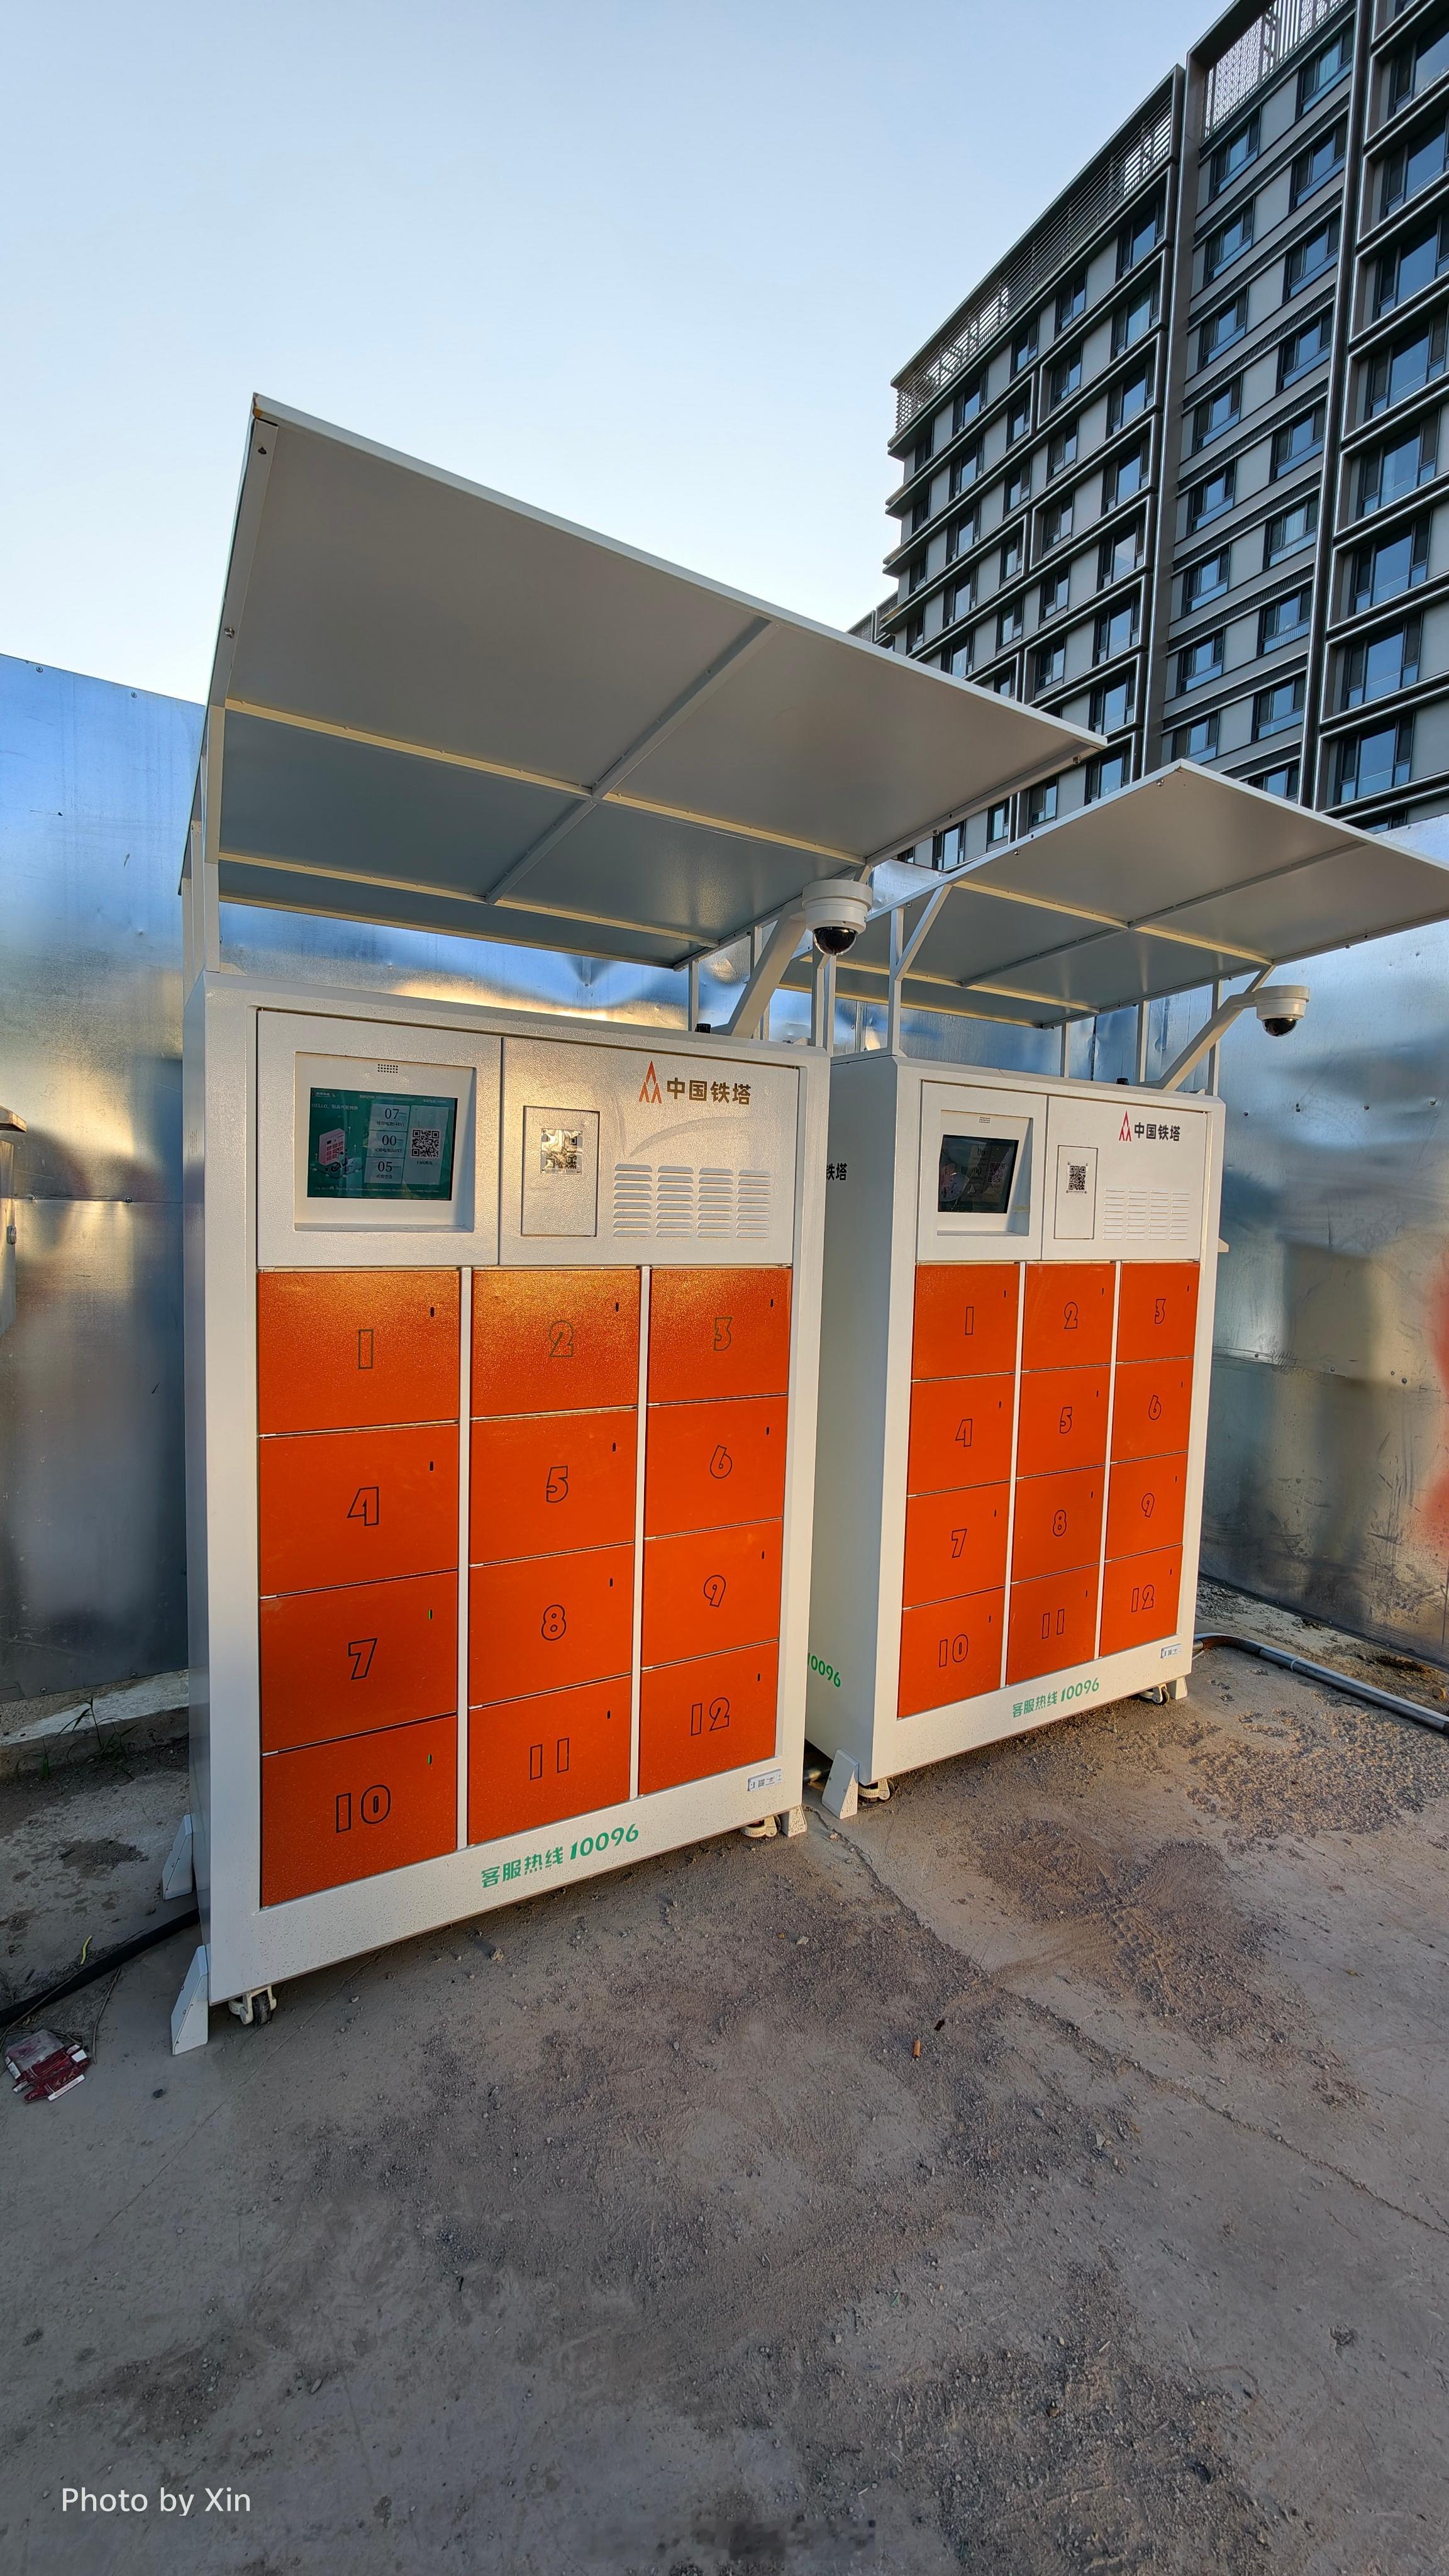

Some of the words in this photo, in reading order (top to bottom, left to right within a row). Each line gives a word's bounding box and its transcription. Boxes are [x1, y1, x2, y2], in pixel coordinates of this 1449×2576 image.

[667, 1077, 751, 1105] 中国铁塔
[385, 1108, 400, 1119] 07
[382, 1135, 397, 1146] 00
[1134, 1121, 1180, 1141] 中国铁塔
[377, 1161, 393, 1172] 05
[965, 1307, 974, 1335] 1
[1064, 1302, 1078, 1330] 2
[1154, 1298, 1167, 1324] 3
[548, 1319, 575, 1358] 2
[713, 1316, 733, 1352] 3
[358, 1330, 373, 1369] 1
[1060, 1406, 1073, 1434] 5
[1148, 1395, 1162, 1421] 6
[955, 1419, 972, 1446] 4
[710, 1445, 732, 1479] 6
[547, 1466, 568, 1502] 5
[347, 1487, 379, 1526] 4
[1141, 1492, 1155, 1518] 9
[1053, 1510, 1066, 1536] 8
[952, 1529, 967, 1558] 7
[704, 1575, 726, 1607] 9
[1131, 1585, 1154, 1612] 12
[541, 1605, 566, 1641] 8
[1042, 1609, 1064, 1639] 11
[348, 1638, 377, 1680] 7
[940, 1635, 968, 1667] 10
[1013, 1690, 1058, 1718] 客服热线
[1061, 1677, 1099, 1702] 10096
[691, 1697, 730, 1736] 12
[530, 1738, 569, 1780] 11
[336, 1785, 391, 1833] 10
[481, 1846, 564, 1888] 客服热线
[570, 1823, 639, 1860] 10096
